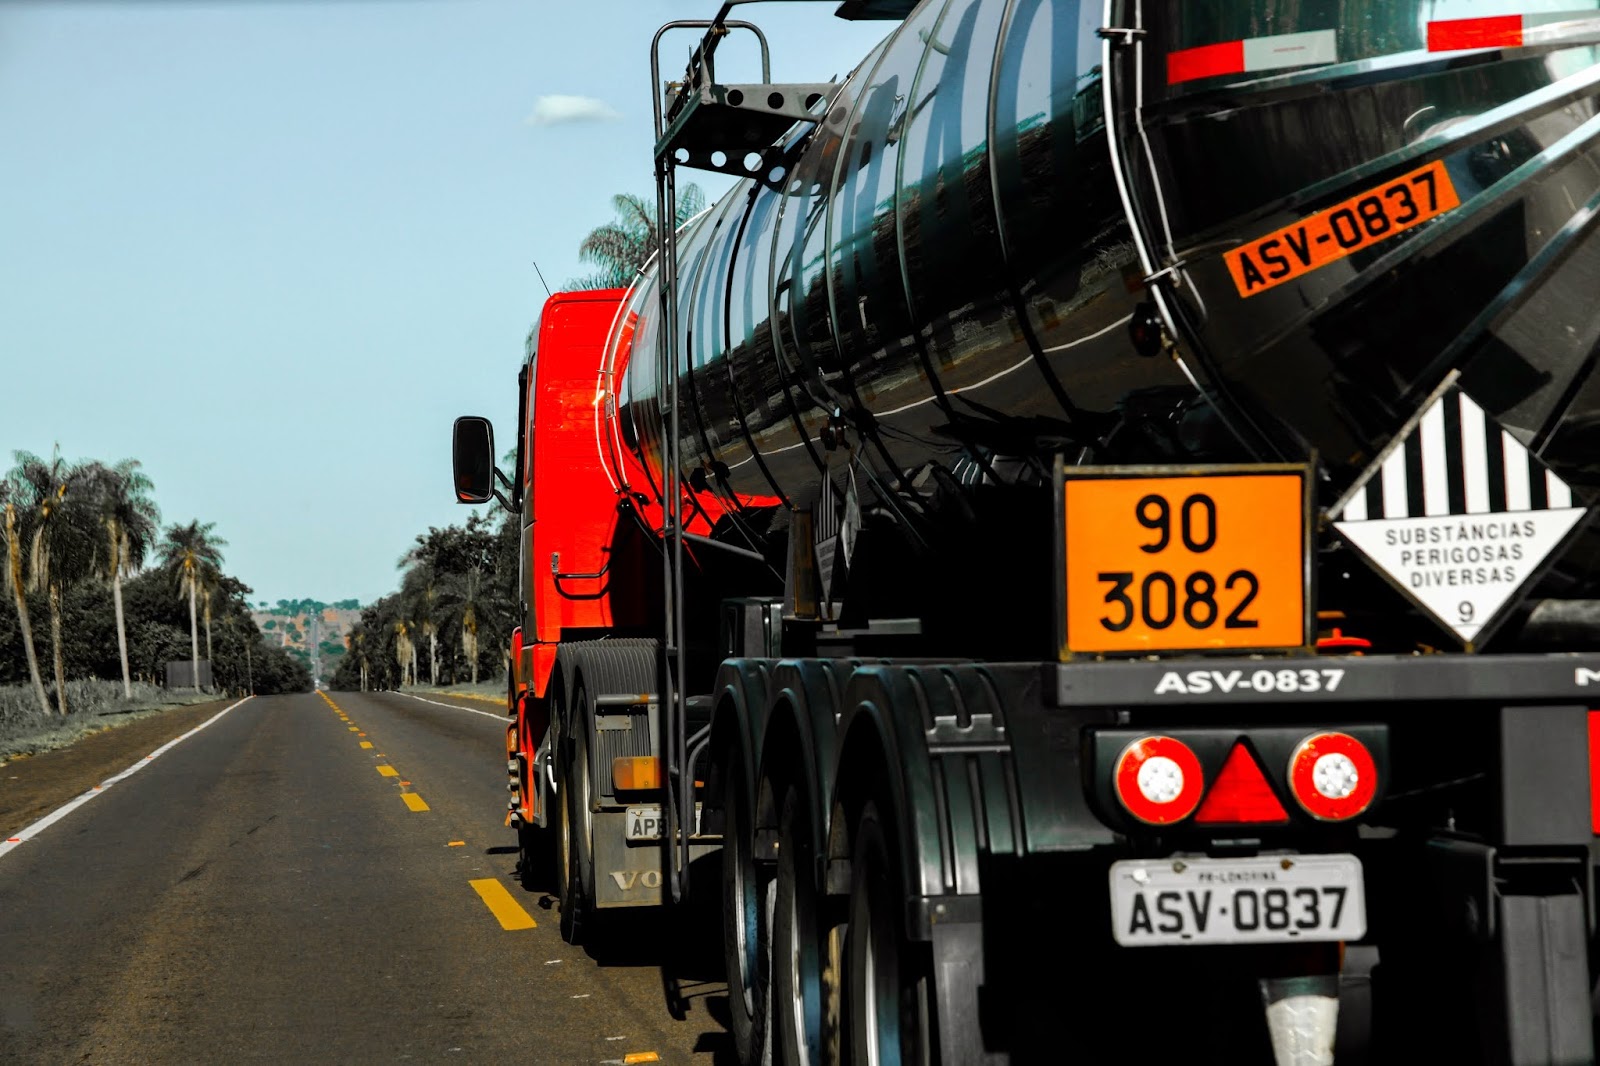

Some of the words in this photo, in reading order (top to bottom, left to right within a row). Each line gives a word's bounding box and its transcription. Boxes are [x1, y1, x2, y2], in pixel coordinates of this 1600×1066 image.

[1240, 170, 1437, 290] ASV-0837
[1136, 493, 1216, 553] 90
[1385, 520, 1536, 545] SUBSTÂNCIAS
[1401, 544, 1523, 566] PERIGOSAS
[1411, 566, 1516, 588] DIVERSAS
[1098, 570, 1259, 632] 3082
[1458, 601, 1475, 622] 9
[1154, 669, 1344, 694] ASV-0837
